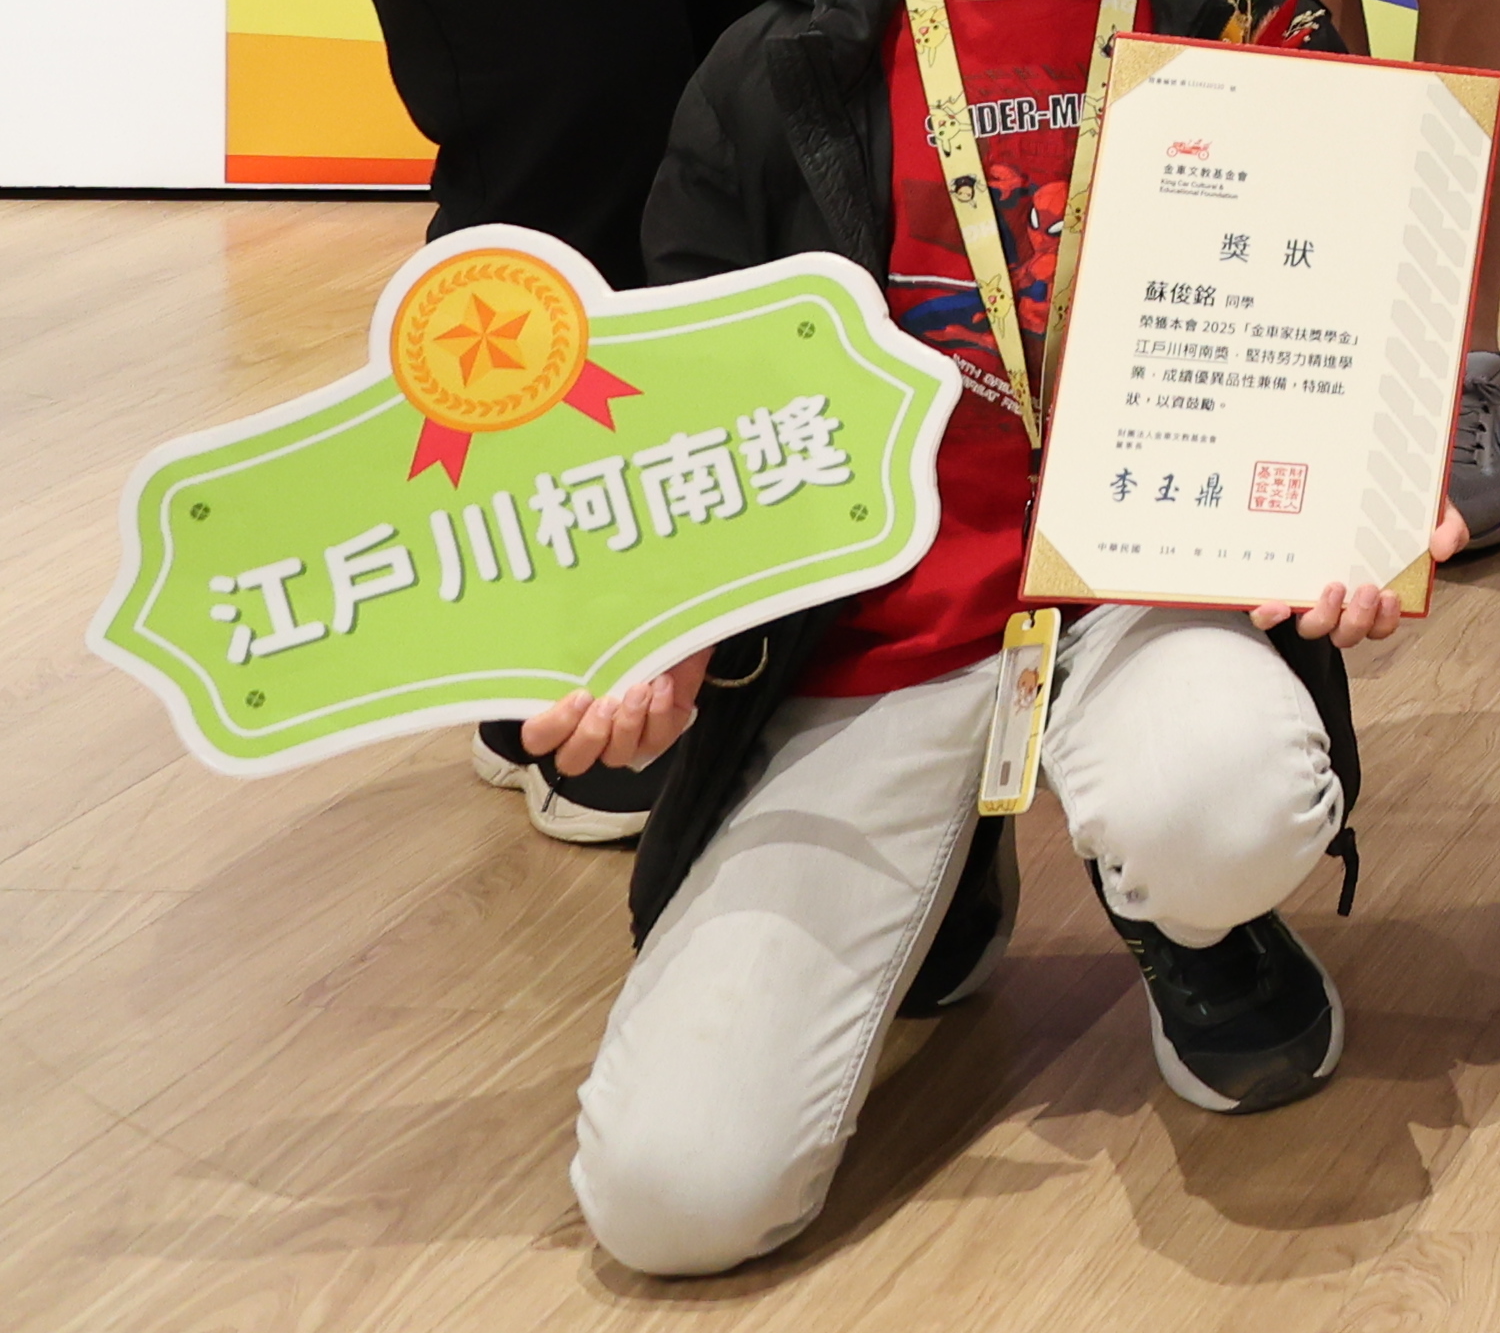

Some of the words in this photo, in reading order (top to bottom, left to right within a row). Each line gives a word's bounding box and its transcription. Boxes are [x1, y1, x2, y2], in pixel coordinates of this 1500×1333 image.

[1163, 163, 1248, 182] 金車文教基金會
[1143, 279, 1217, 306] 蘇俊銘
[1225, 293, 1255, 310] 同學
[209, 394, 852, 666] 江戶川柯南獎
